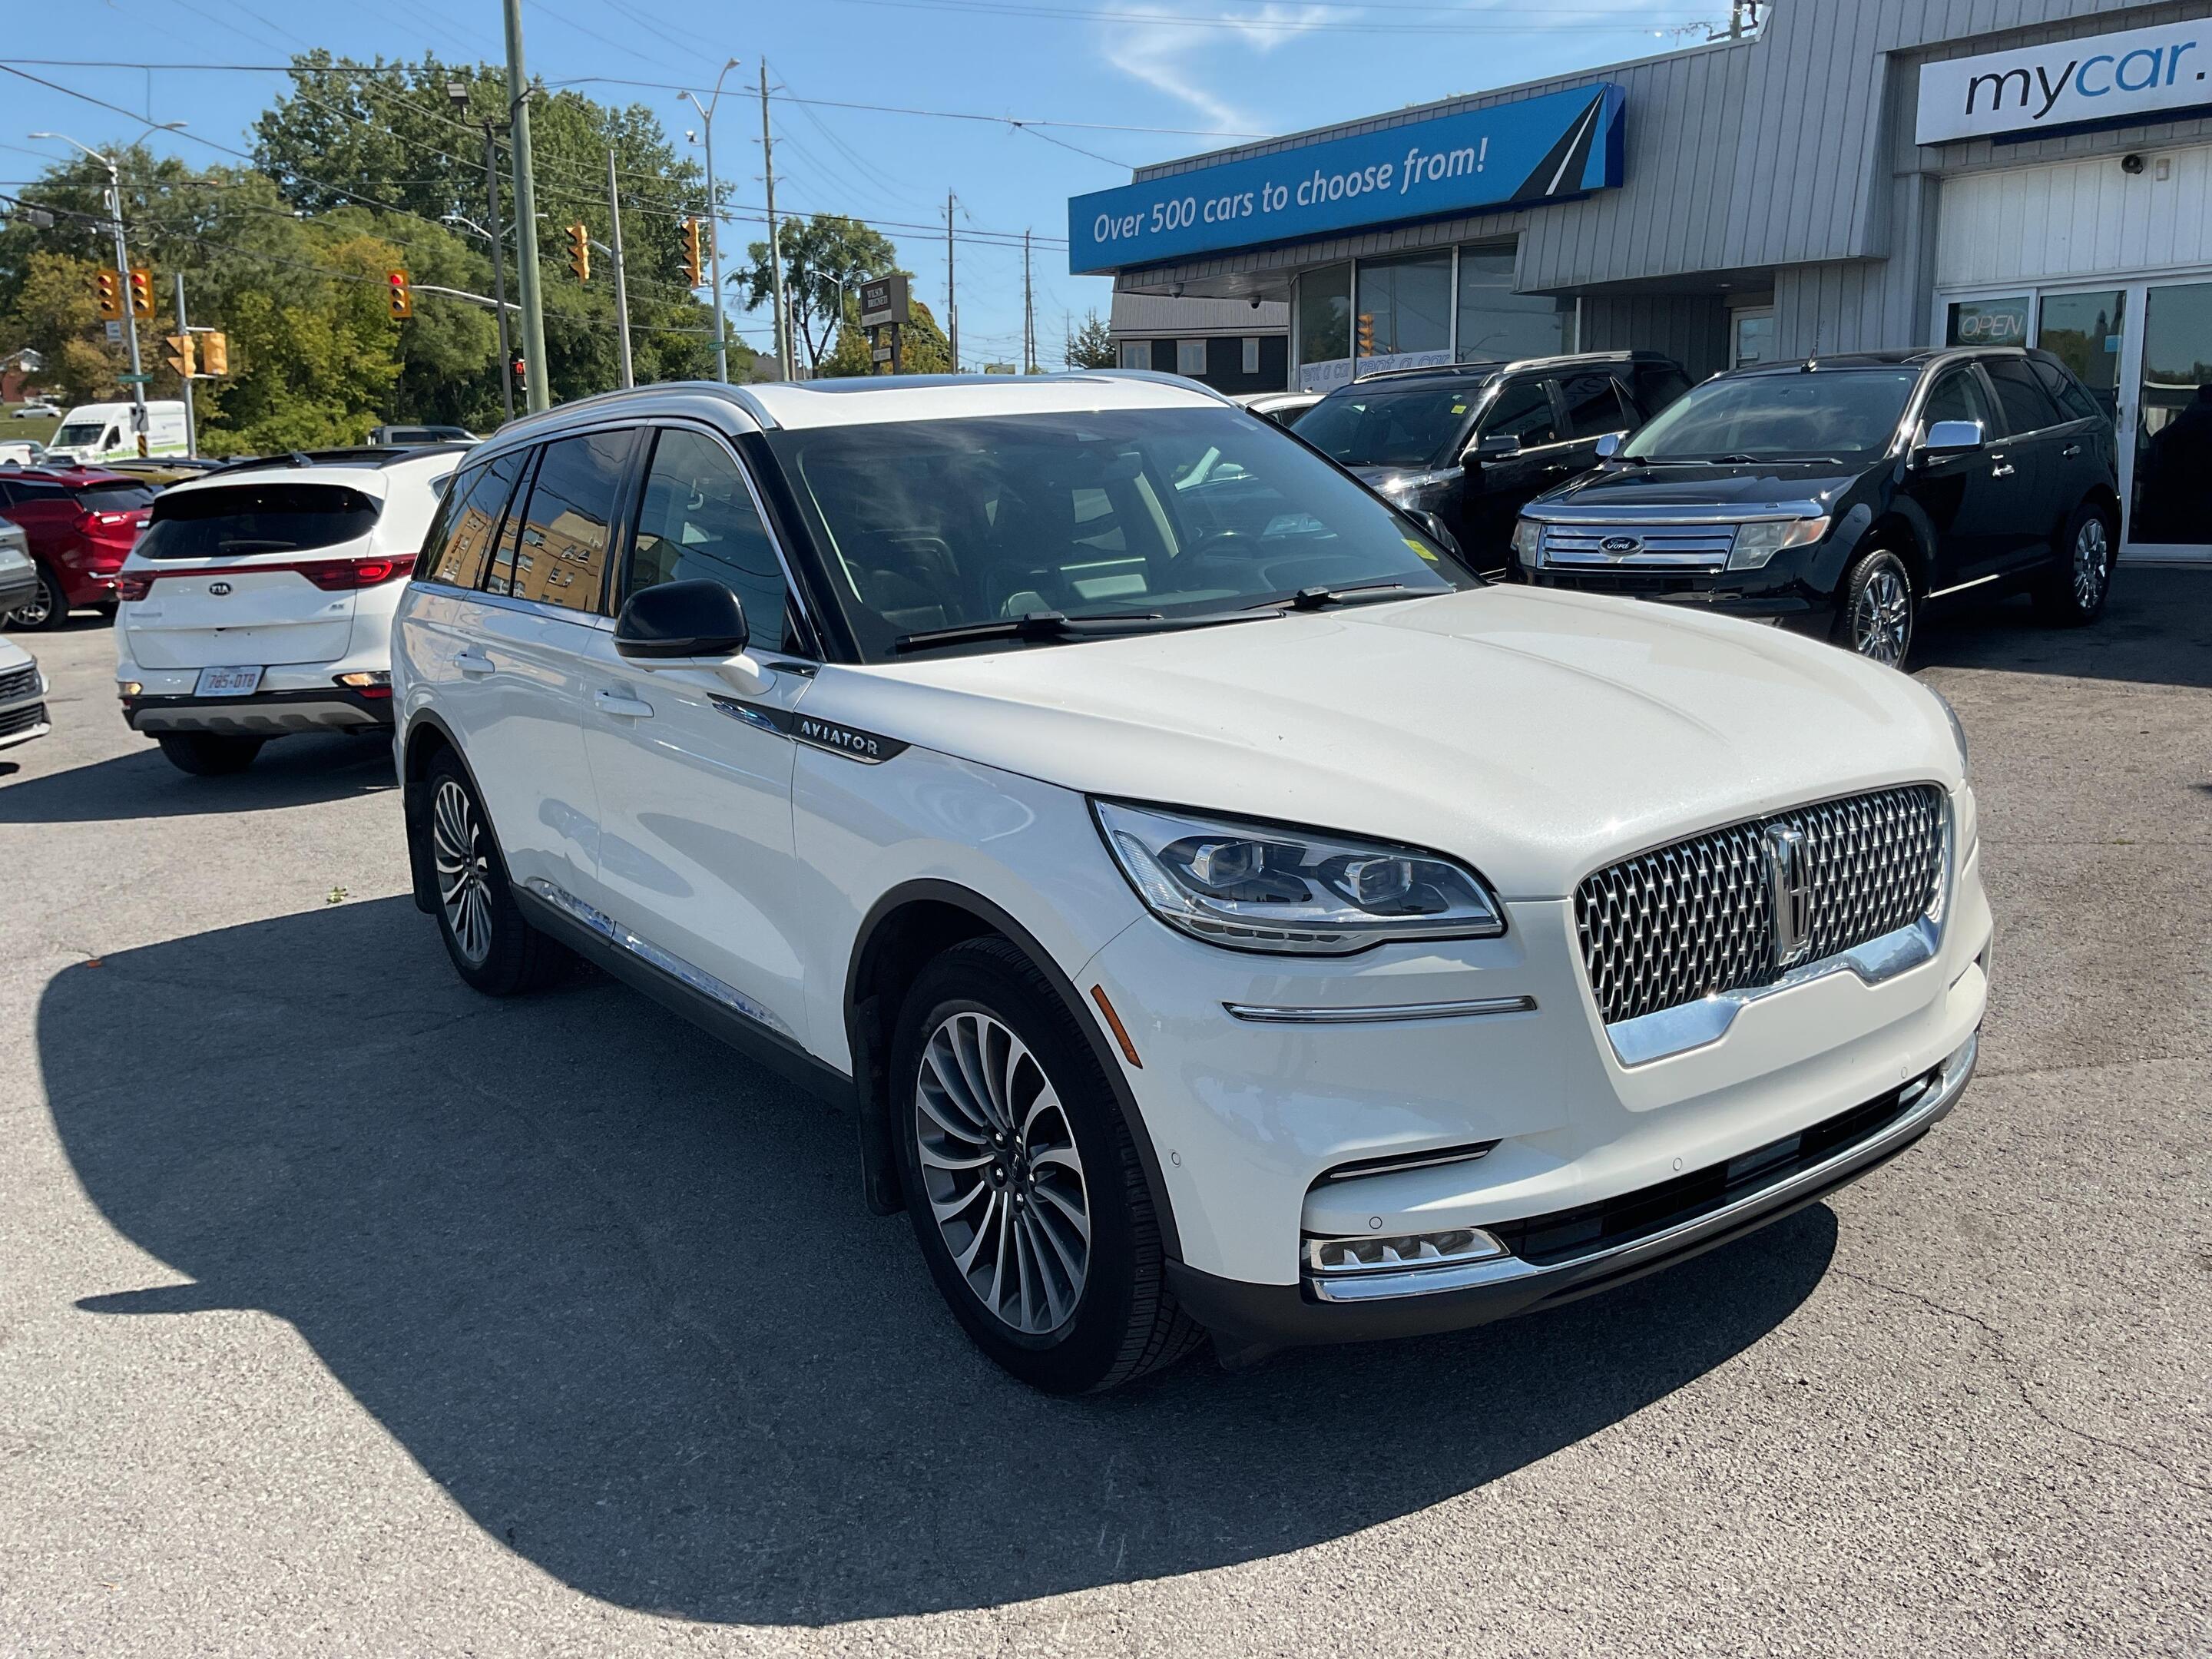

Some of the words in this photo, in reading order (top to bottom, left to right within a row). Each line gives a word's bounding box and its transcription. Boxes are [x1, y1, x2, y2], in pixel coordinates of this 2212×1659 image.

[1094, 213, 1145, 243] Over
[1150, 197, 1196, 233] 500
[1204, 192, 1254, 224] cars
[1262, 181, 1288, 213] to
[1296, 164, 1393, 206] choose
[1400, 137, 1488, 195] from!
[1962, 315, 2023, 336] OPEN
[1357, 355, 1395, 376] rent
[1607, 538, 1631, 549] Ford
[211, 584, 229, 593] KIA
[800, 720, 879, 755] AVIATOR
